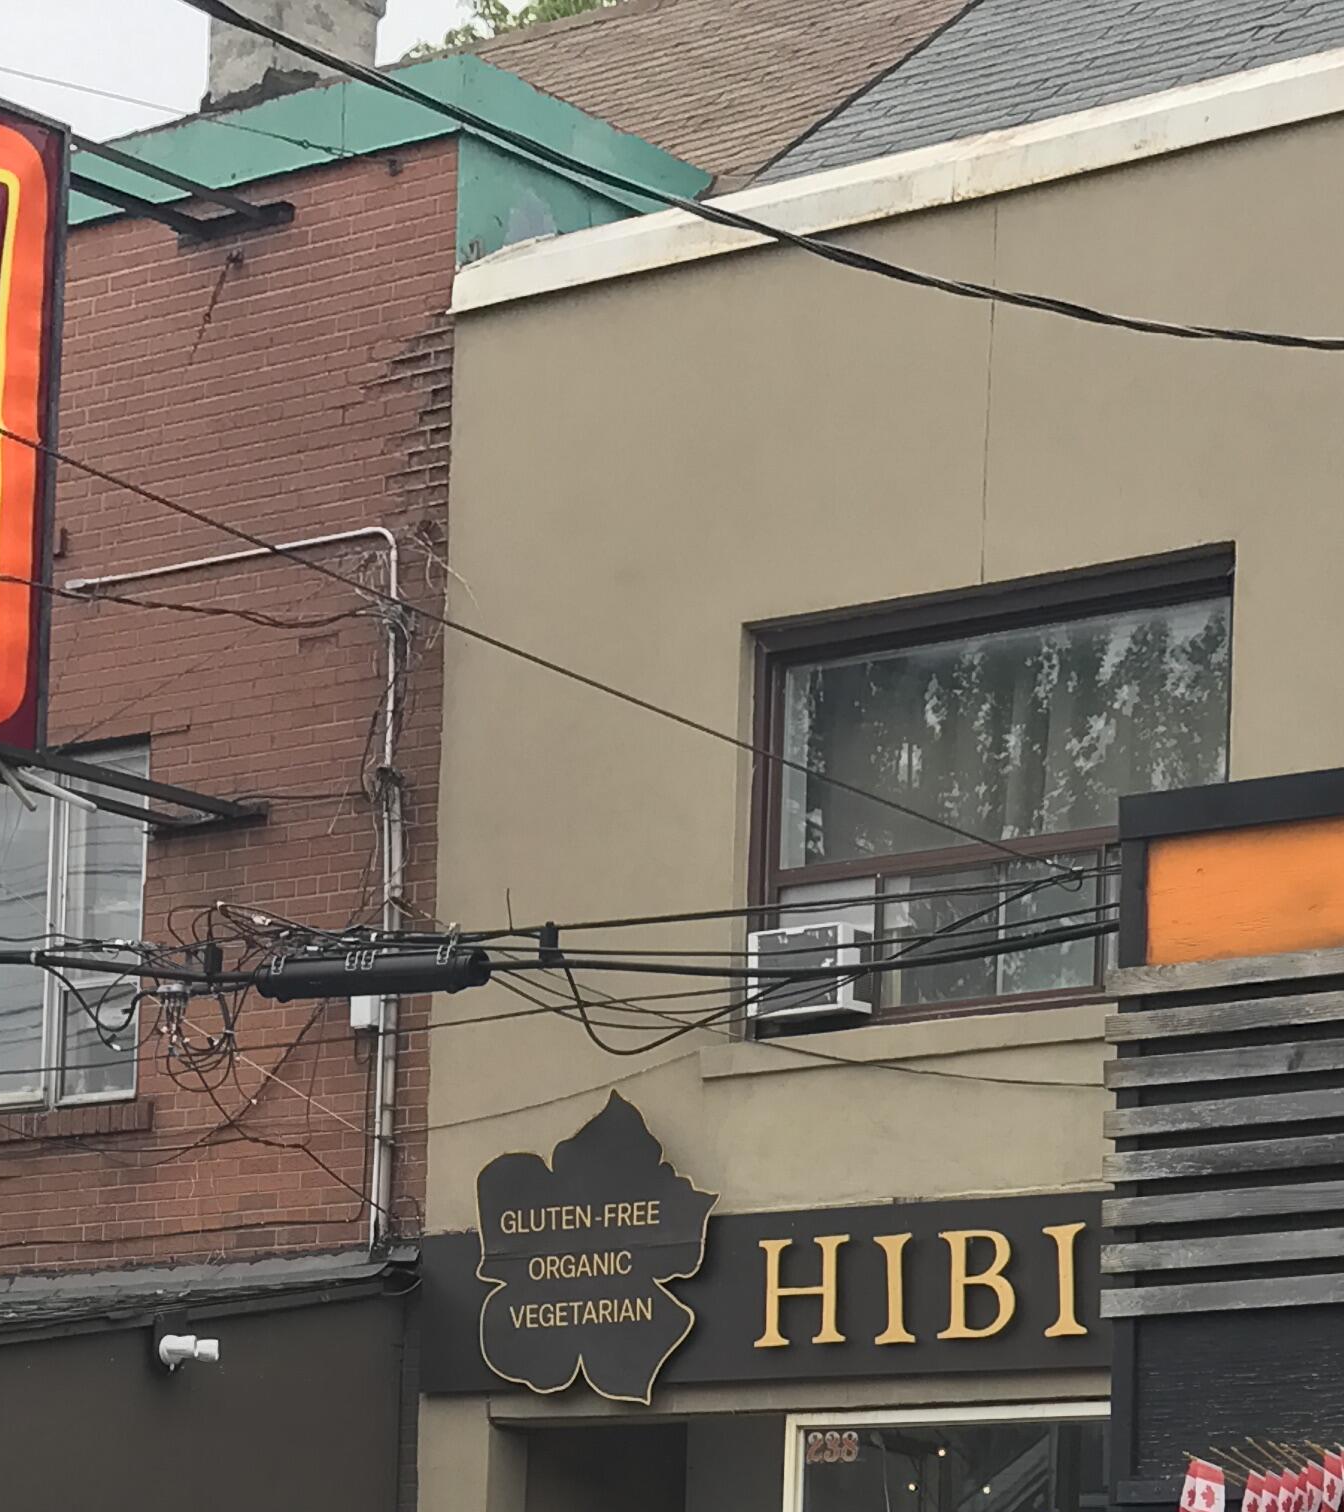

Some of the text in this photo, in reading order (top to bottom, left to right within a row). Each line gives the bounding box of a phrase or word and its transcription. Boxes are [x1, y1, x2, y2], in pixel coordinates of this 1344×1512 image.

[500, 1200, 660, 1234] GLUTEN-FREE
[528, 1250, 632, 1281] ORGANIC
[509, 1297, 653, 1329] VEGETARIAN
[806, 1431, 859, 1464] 238
